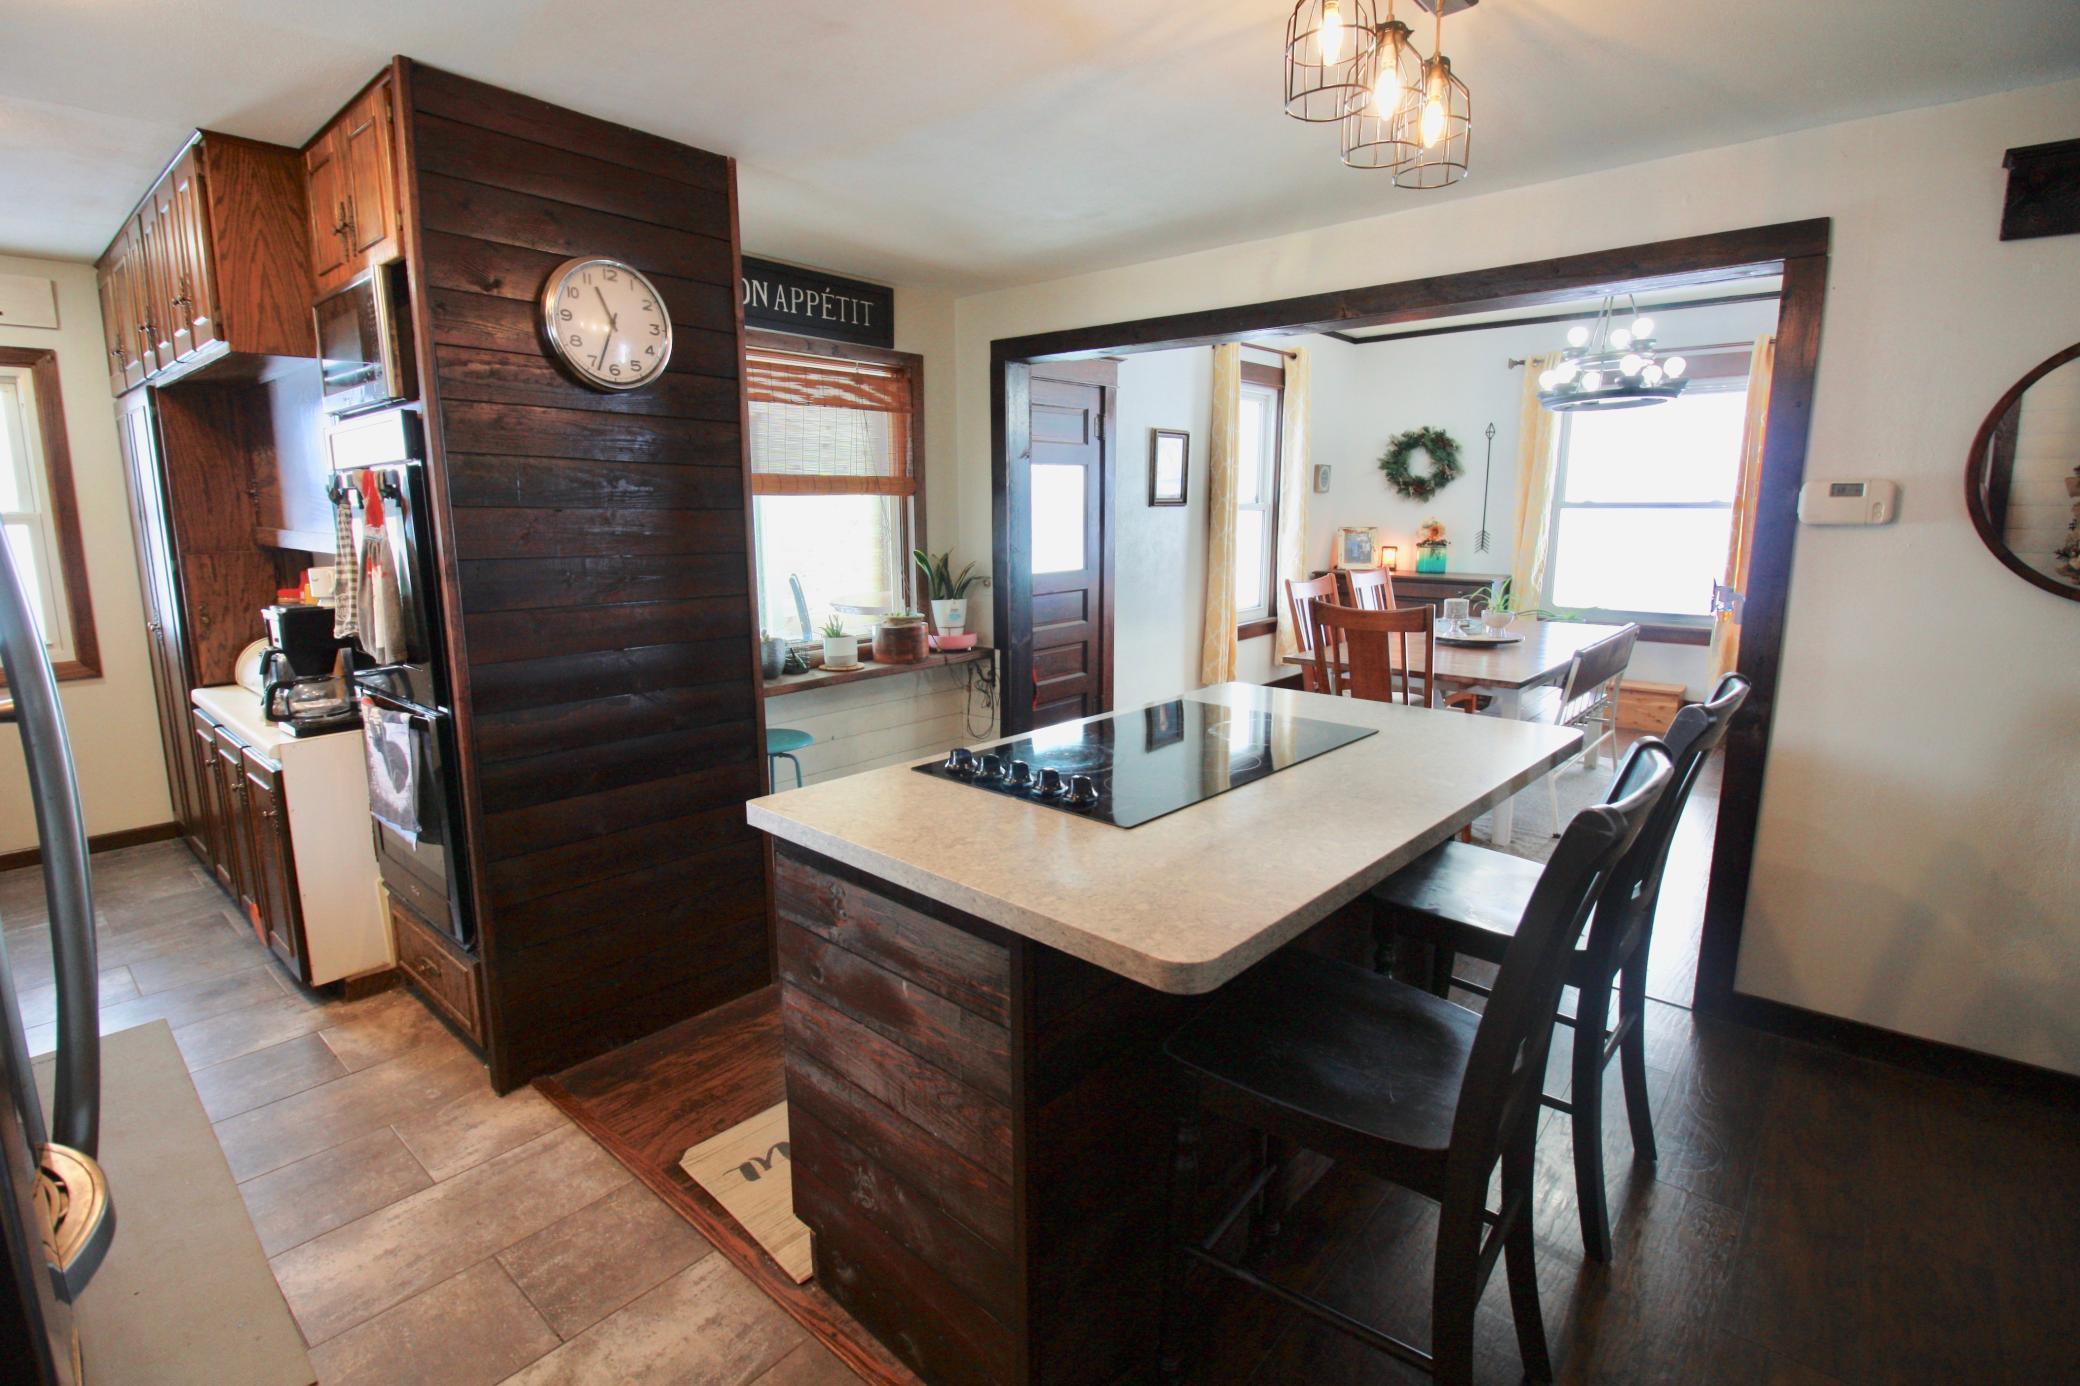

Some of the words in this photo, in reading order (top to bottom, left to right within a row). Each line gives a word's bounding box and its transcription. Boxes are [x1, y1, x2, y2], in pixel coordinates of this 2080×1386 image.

[582, 272, 592, 285] 11
[603, 268, 618, 282] 12
[567, 286, 580, 299] 10
[642, 299, 653, 312] 2
[774, 284, 875, 327] APPÉTIT
[560, 309, 573, 321] 9
[649, 324, 660, 336] 3
[570, 334, 583, 347] 8
[645, 345, 655, 356] 4
[587, 354, 598, 367] 7
[630, 360, 642, 372] 5
[609, 364, 621, 376] 6
